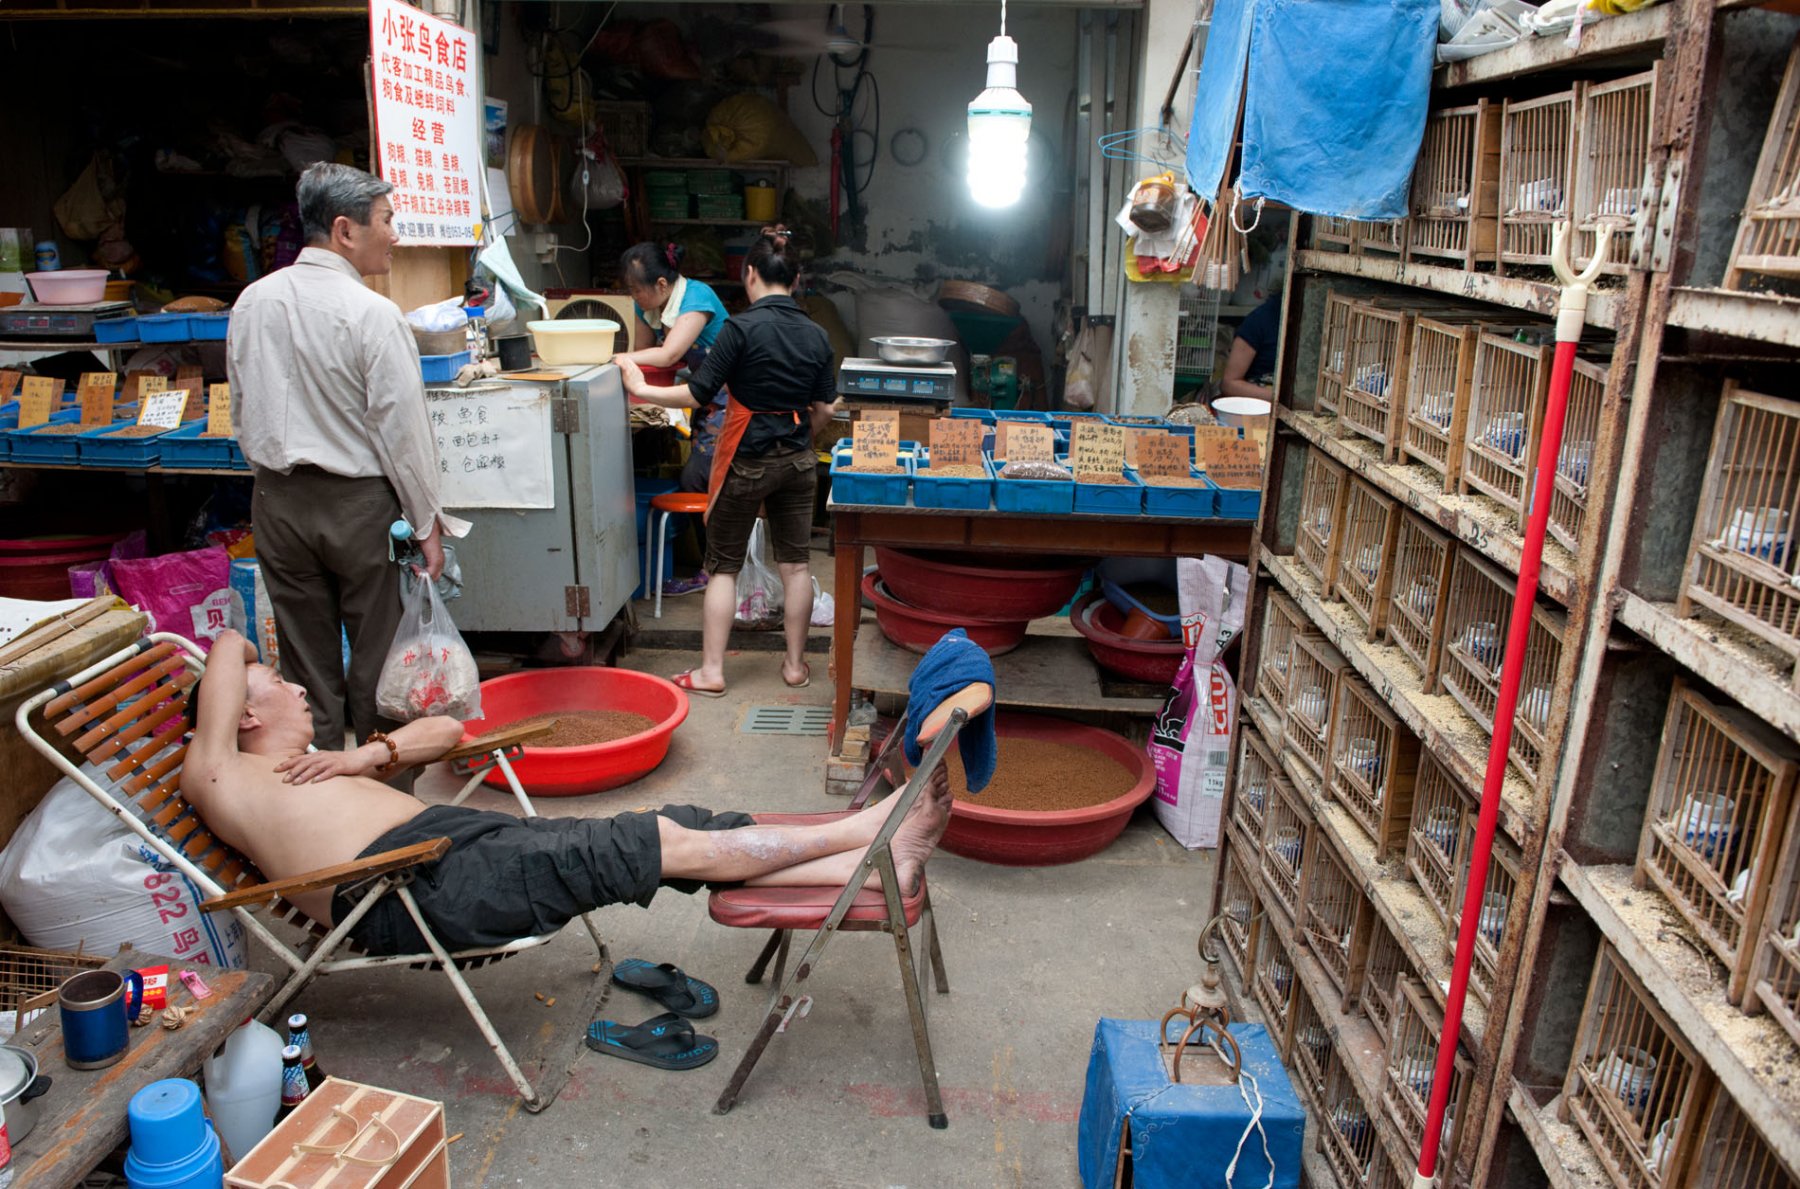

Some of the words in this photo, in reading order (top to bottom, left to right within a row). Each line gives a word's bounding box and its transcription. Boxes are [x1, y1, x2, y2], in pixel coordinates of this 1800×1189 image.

[382, 8, 467, 73] 小张鸟食店
[382, 78, 455, 116] 狗食及蟋蟀饲料
[412, 117, 445, 145] 经营
[397, 222, 435, 238] 欢迎惠顾
[1211, 666, 1228, 731] CLU
[144, 873, 188, 925] 822
